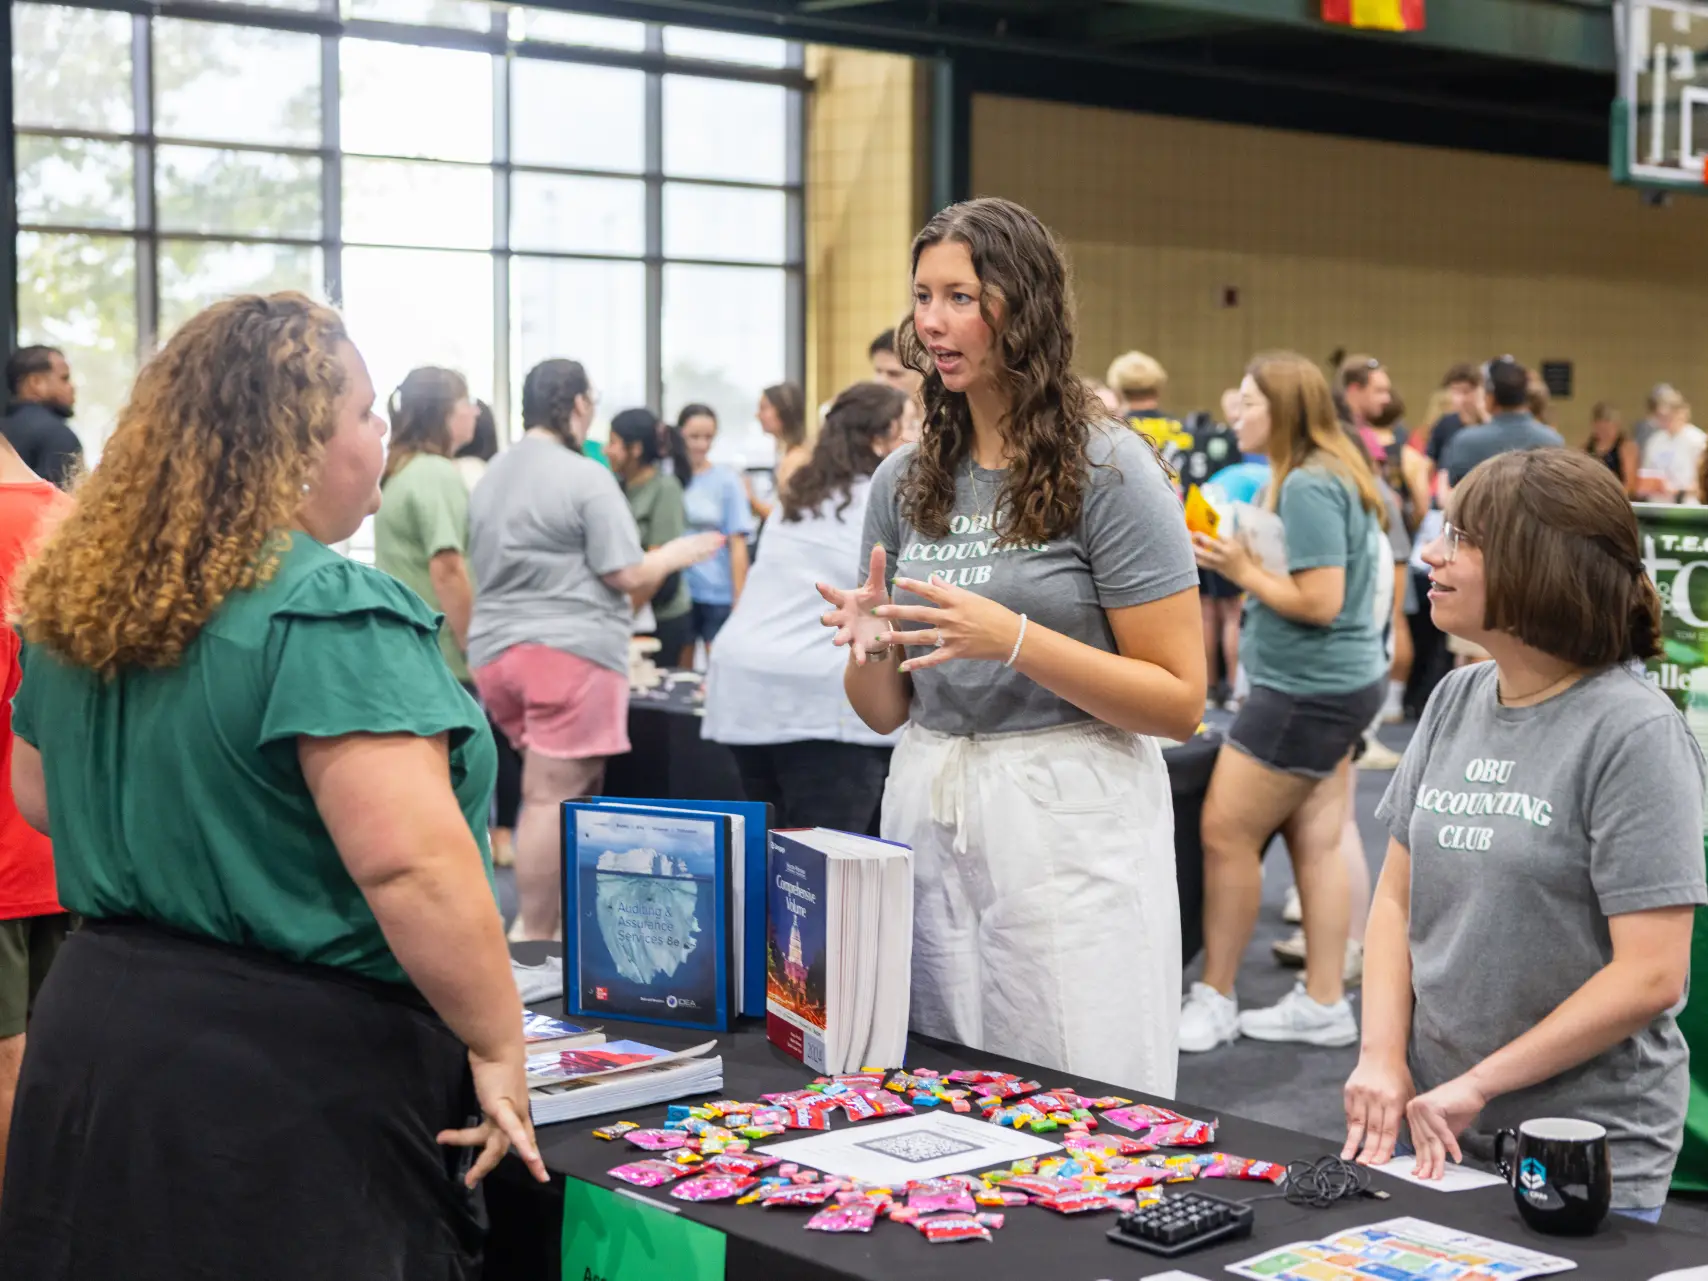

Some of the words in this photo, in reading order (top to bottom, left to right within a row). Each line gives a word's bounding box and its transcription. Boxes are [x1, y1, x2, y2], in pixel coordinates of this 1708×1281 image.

[1465, 758, 1516, 784] OBU
[1437, 825, 1494, 851] CLUB
[776, 874, 817, 905] Comprehensive
[618, 902, 662, 919] Auditing
[665, 906, 673, 917] &
[785, 896, 807, 919] Volume
[618, 916, 674, 932] Assurance
[617, 929, 664, 945] Services
